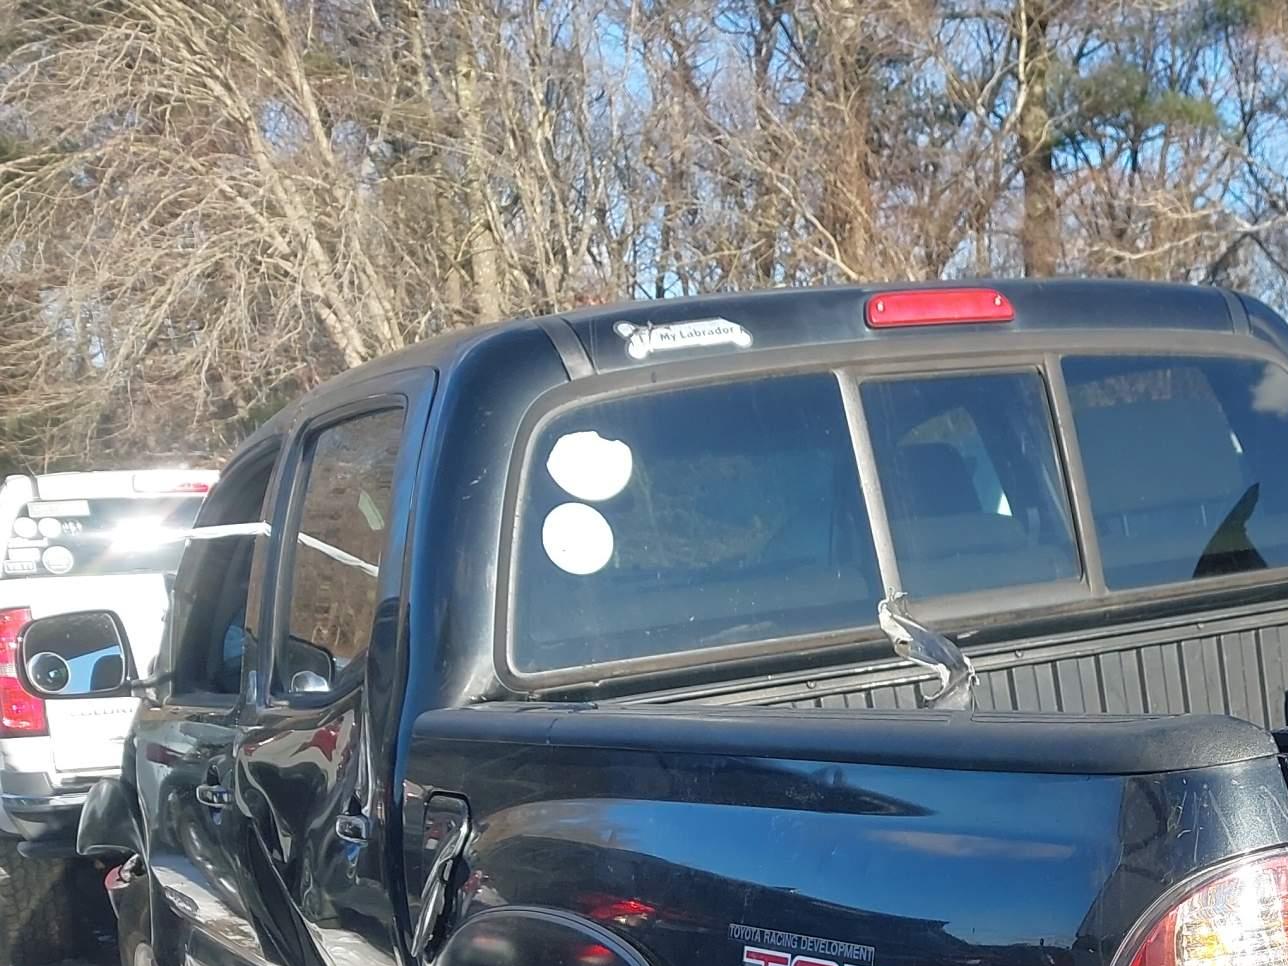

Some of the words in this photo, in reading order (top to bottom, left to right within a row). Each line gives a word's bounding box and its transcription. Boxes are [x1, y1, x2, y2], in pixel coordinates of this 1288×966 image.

[660, 333, 677, 343] My
[679, 326, 735, 340] Labrador
[729, 924, 761, 942] TOYOTA
[763, 930, 798, 949] RACING
[800, 936, 875, 962] DEVELOPMENT
